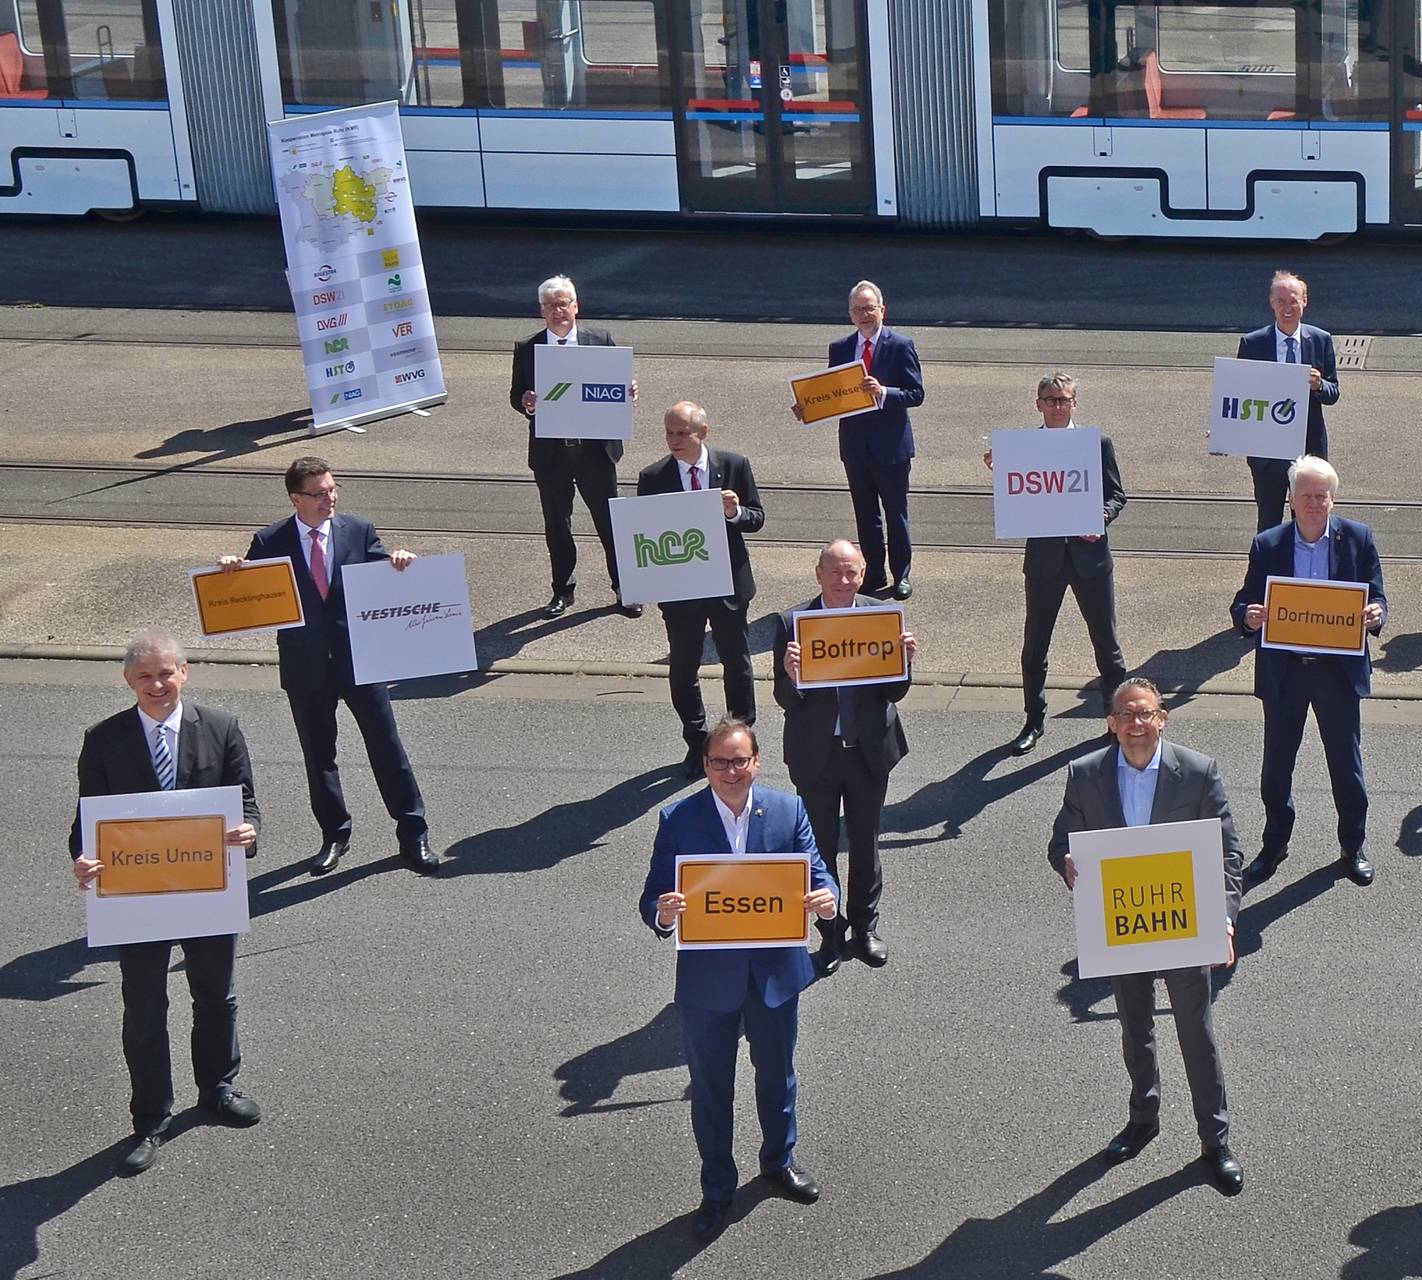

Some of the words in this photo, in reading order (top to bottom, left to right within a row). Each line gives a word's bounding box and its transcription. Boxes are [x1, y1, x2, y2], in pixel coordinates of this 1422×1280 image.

[313, 290, 345, 306] DSW21
[392, 322, 413, 338] VER
[402, 369, 425, 381] WVG
[585, 387, 623, 399] NIAG
[804, 395, 830, 406] Kreis
[1008, 469, 1089, 495] DSW21
[360, 602, 440, 621] VESTISCHE
[1277, 607, 1355, 627] Dortmund
[811, 639, 894, 661] Bottrop
[111, 850, 160, 866] Kreis
[166, 848, 213, 863] Unna
[705, 891, 783, 914] Essen
[1112, 882, 1184, 909] RUHR
[1115, 909, 1188, 936] BAHN
